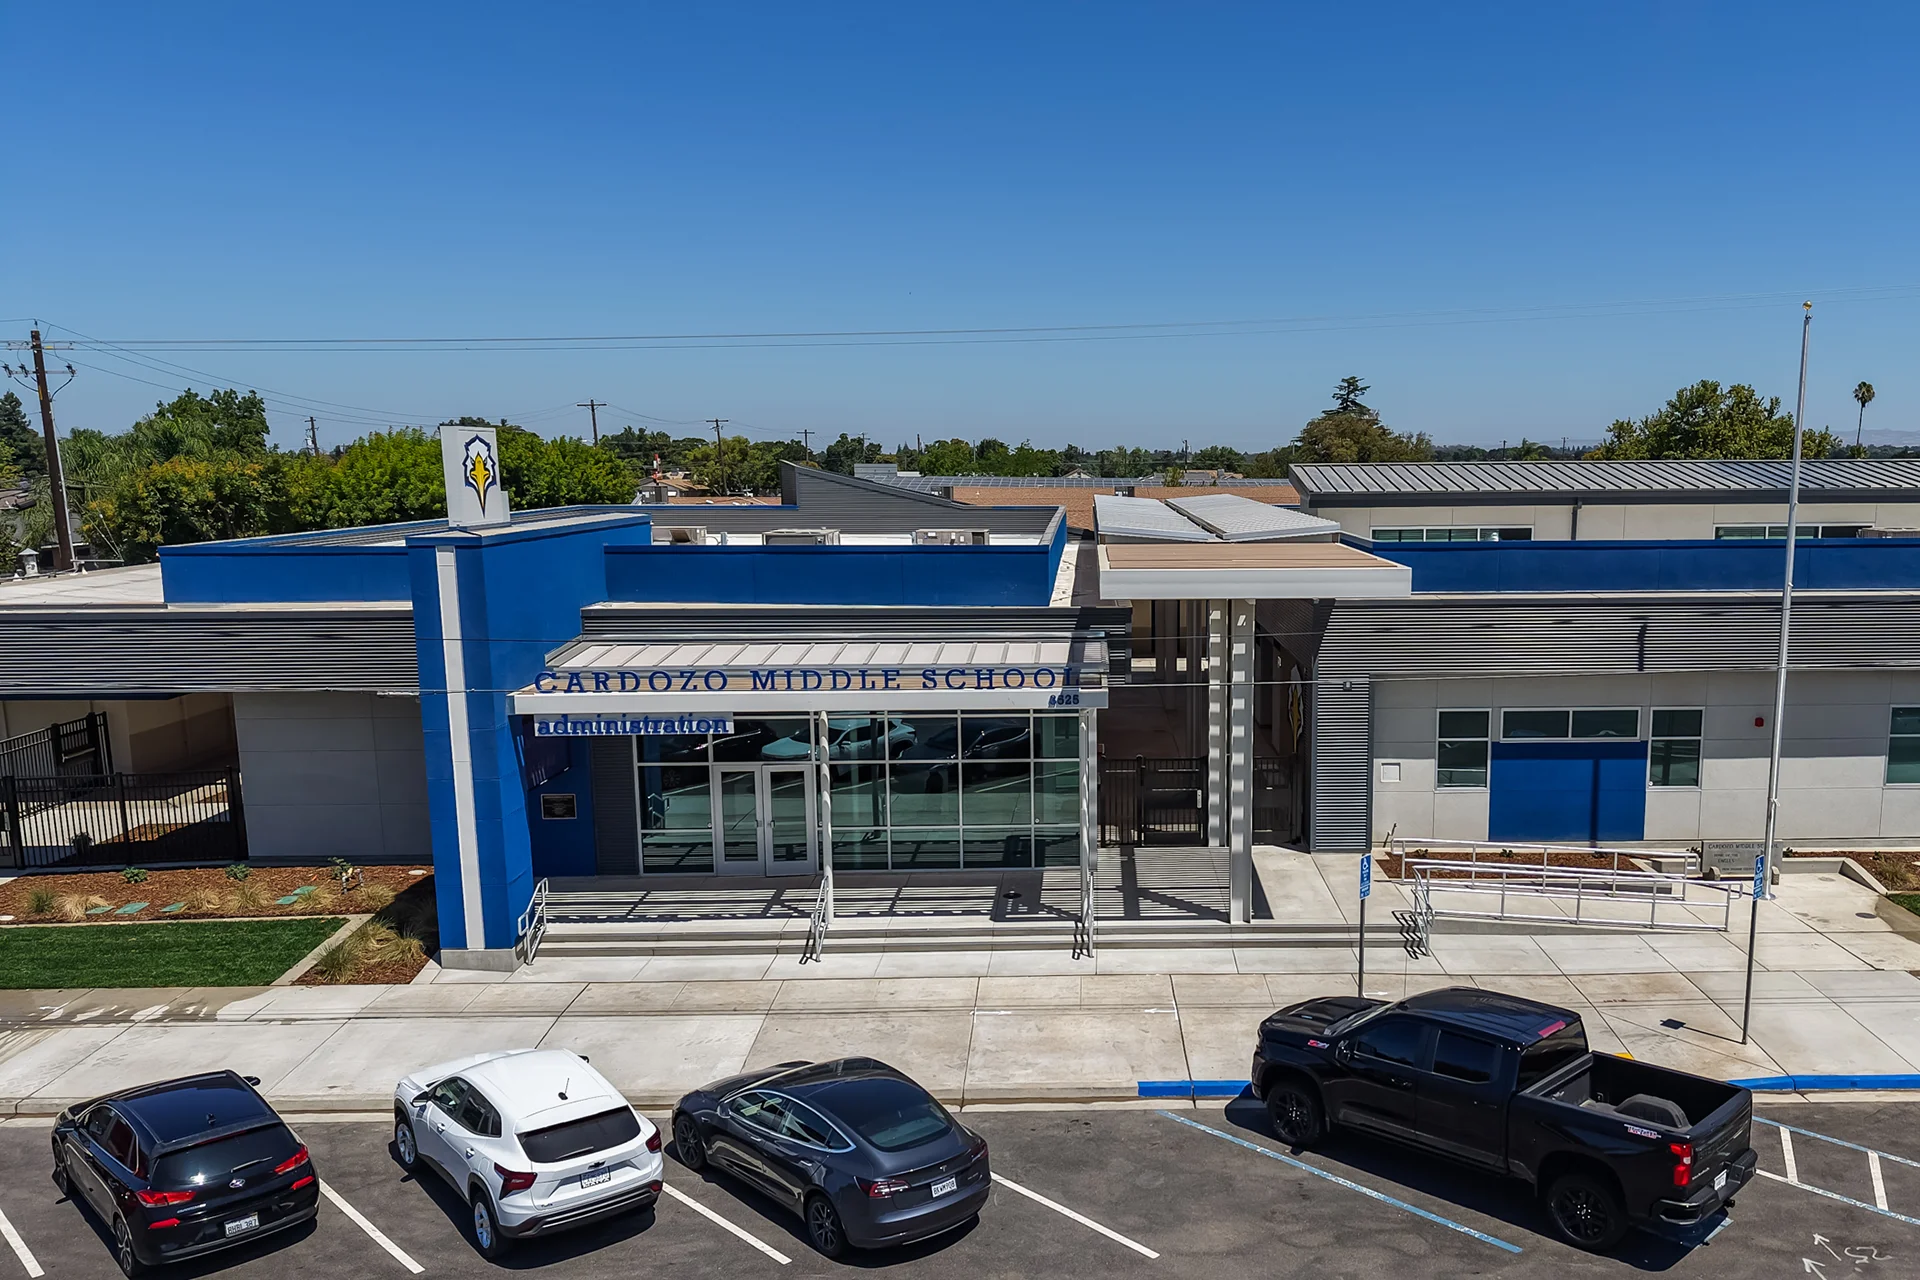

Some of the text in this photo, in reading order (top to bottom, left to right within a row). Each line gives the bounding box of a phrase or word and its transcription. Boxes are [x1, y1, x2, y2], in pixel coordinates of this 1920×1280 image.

[534, 666, 1079, 693] CARDOZO MIDDLE SCHOOL
[537, 713, 730, 735] administration
